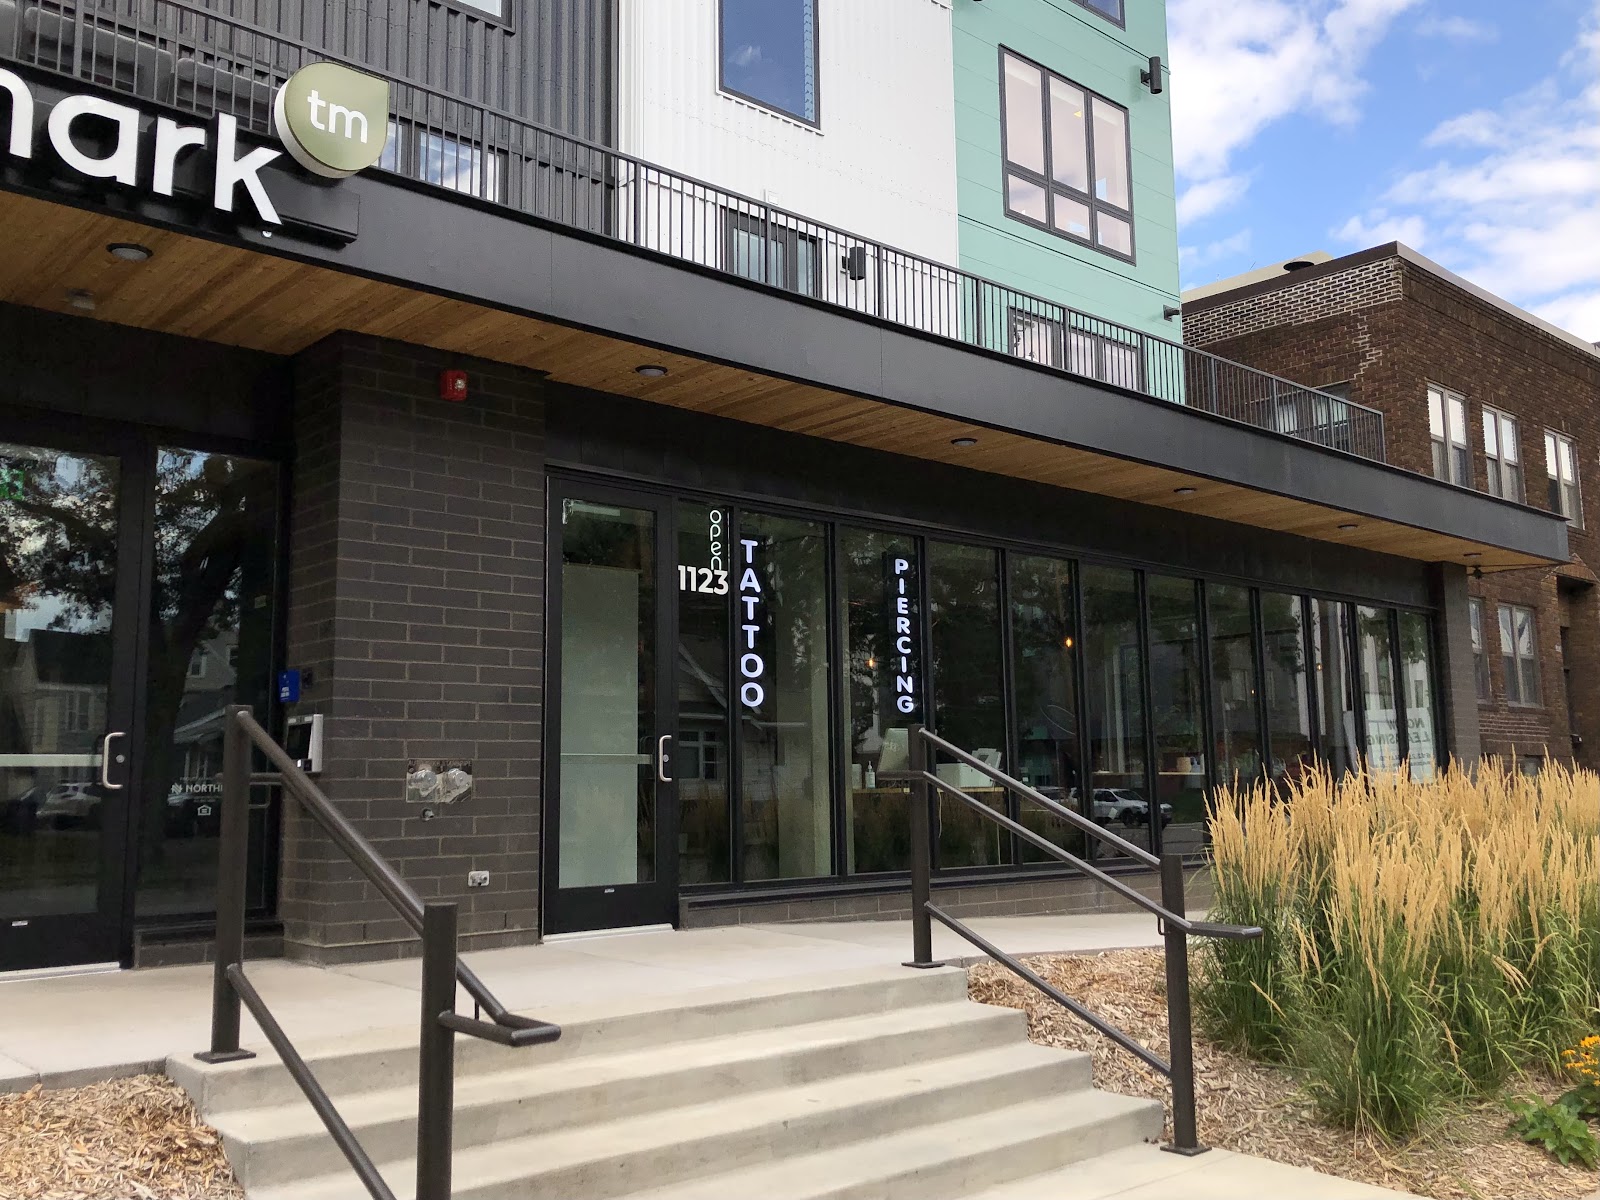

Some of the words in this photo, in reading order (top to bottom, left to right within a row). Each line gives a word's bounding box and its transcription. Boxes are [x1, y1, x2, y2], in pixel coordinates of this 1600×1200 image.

[307, 89, 368, 144] tm
[709, 509, 722, 570] open
[677, 564, 729, 595] 1123
[740, 538, 764, 708] TATTOO
[894, 558, 914, 713] PIERCING
